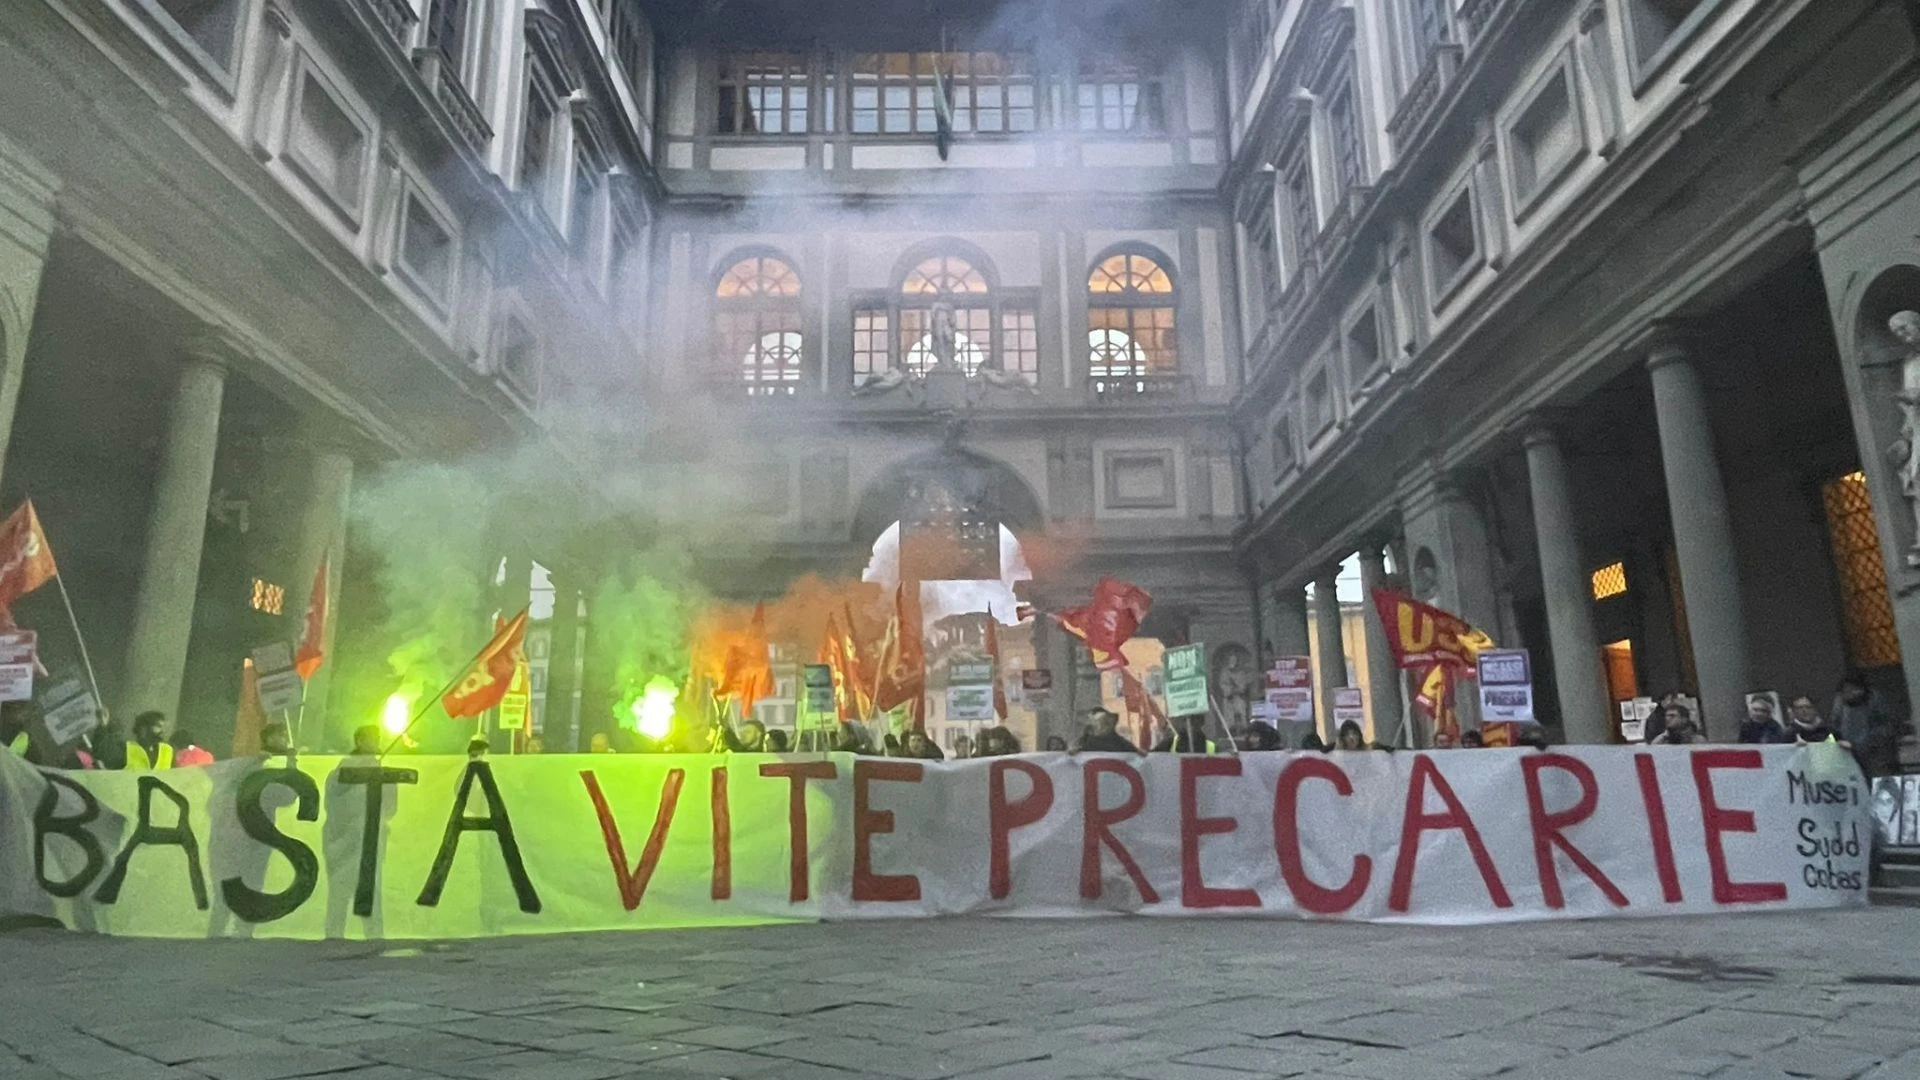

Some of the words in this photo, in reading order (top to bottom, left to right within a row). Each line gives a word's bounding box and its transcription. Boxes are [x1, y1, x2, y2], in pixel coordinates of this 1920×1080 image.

[1786, 769, 1859, 806] Musei
[34, 761, 542, 923] BASTA
[579, 761, 924, 911] VITE
[989, 750, 1787, 913] PRECARIE
[1796, 817, 1860, 858] Sudd
